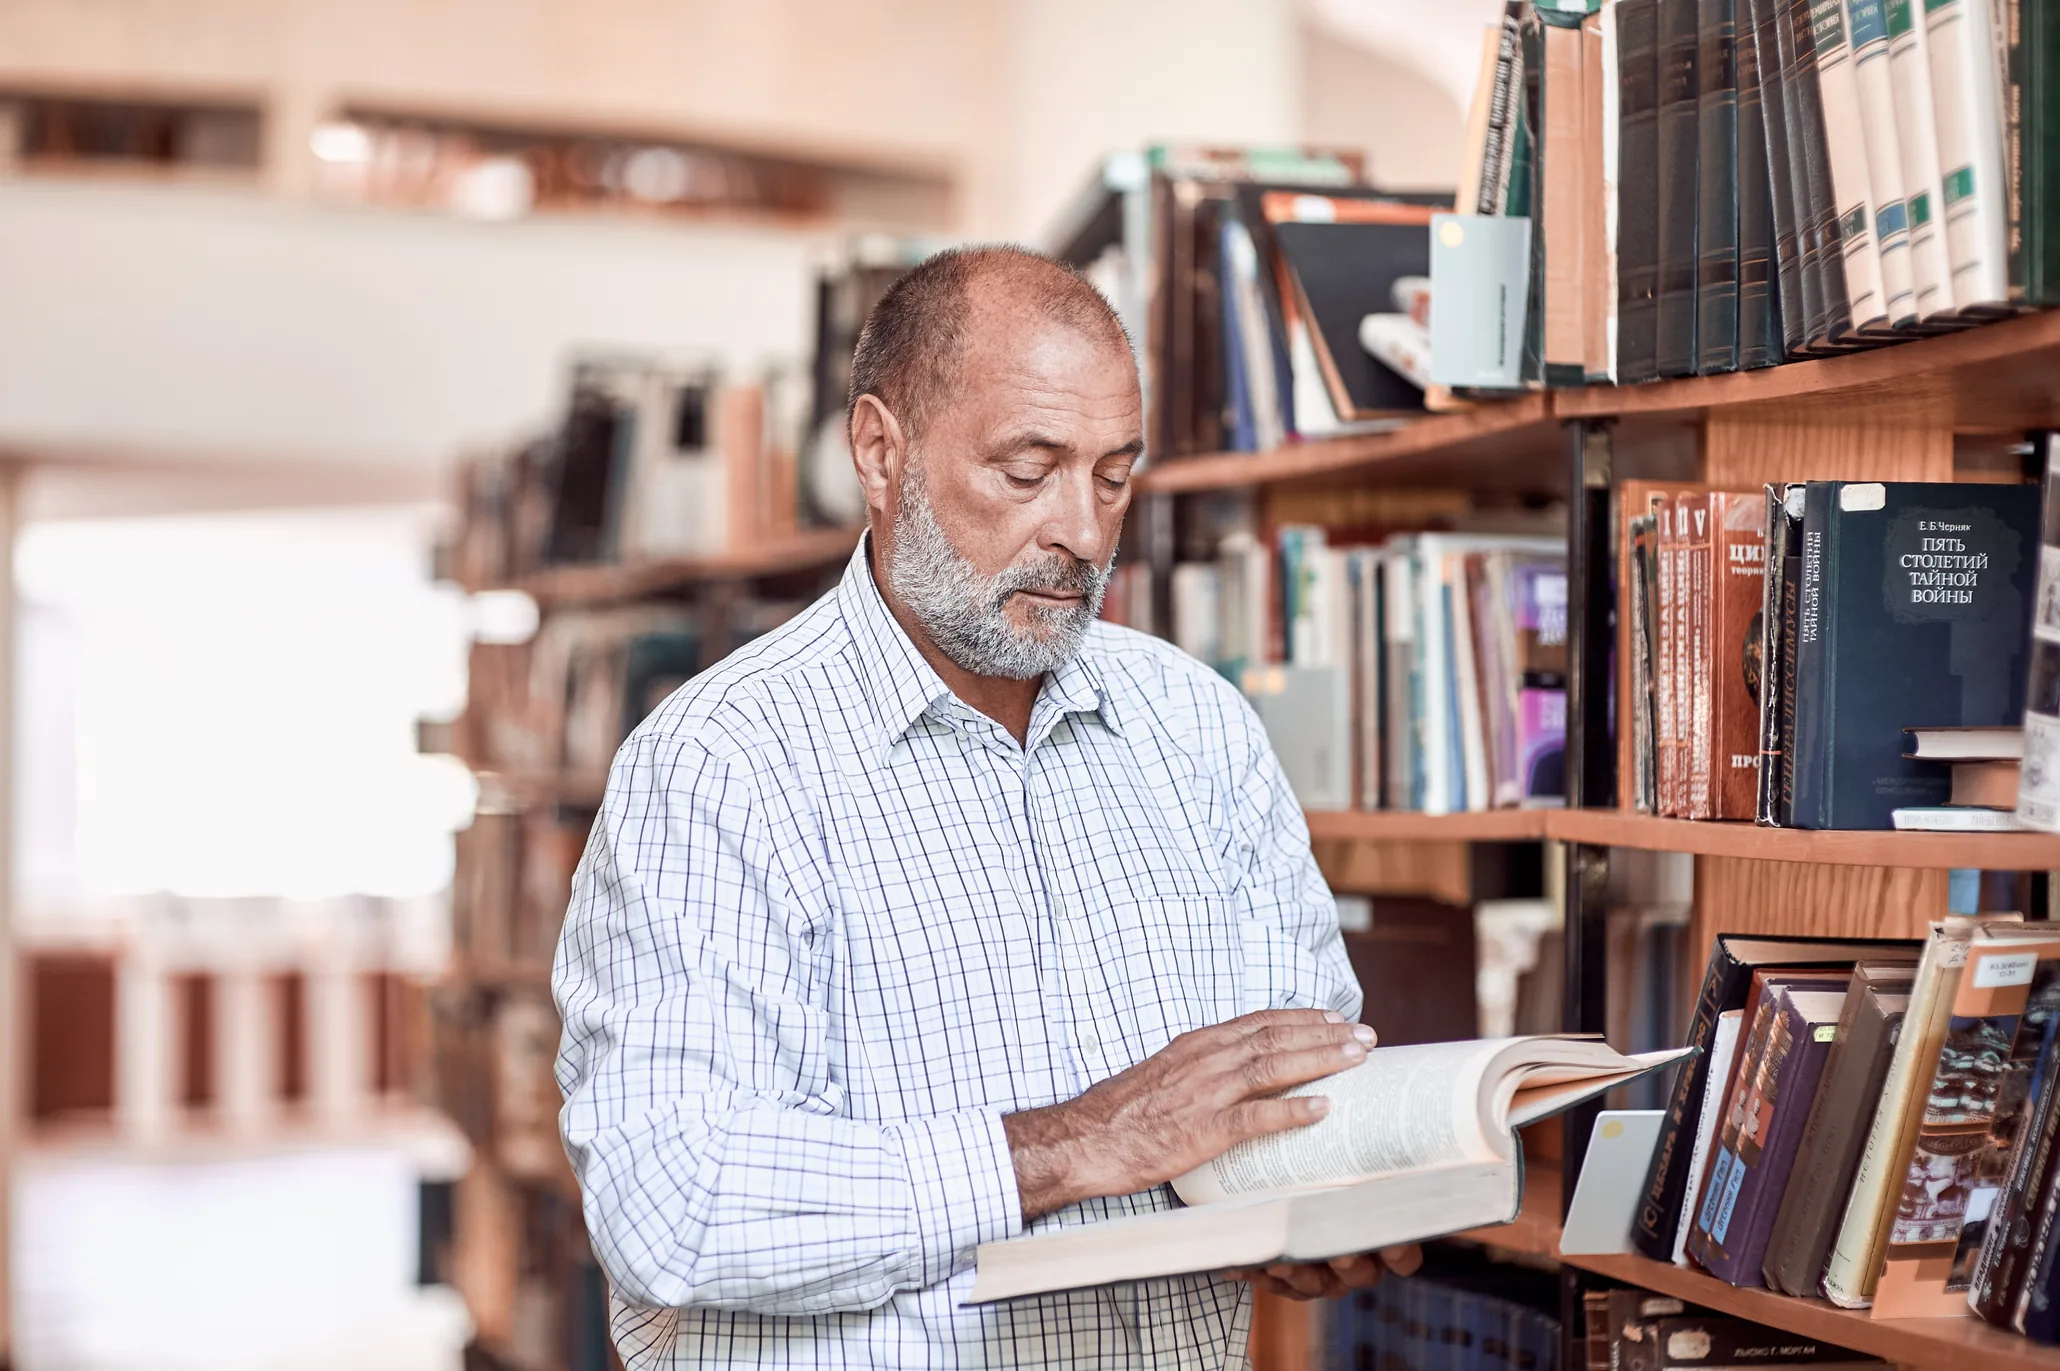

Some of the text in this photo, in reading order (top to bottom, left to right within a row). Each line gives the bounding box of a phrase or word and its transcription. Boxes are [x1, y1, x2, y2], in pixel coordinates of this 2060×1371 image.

[1664, 508, 1671, 537] I
[1693, 508, 1707, 537] V
[1938, 521, 1972, 532] Черняк
[1900, 552, 1989, 569] СТОЛЕТИЙ
[1922, 537, 1966, 552] ПЯТЬ
[1802, 531, 1813, 643] ПЯТЬ СТОЛЕТИЙ
[1810, 531, 1821, 642] ТАЙНОЙ ВОЙНЫ
[1909, 569, 1979, 587] ТАЙНОЙ
[1911, 586, 1974, 604] ВОЙНЫ
[1784, 579, 1796, 805] ГЕНЕРАЛИССИМУСЫ
[1652, 1130, 1676, 1200] ЦЕЗАРЬ
[1678, 1022, 1706, 1105] ХРИСОС
[1859, 1109, 1884, 1183] ИСТОРИЯ
[2017, 1146, 2033, 1192] ВЕКОВЫЕ
[1974, 1232, 1995, 1290] ВЛАДИМИР
[1996, 1115, 2027, 1217] ИНФОРМАЦИОННОЕ
